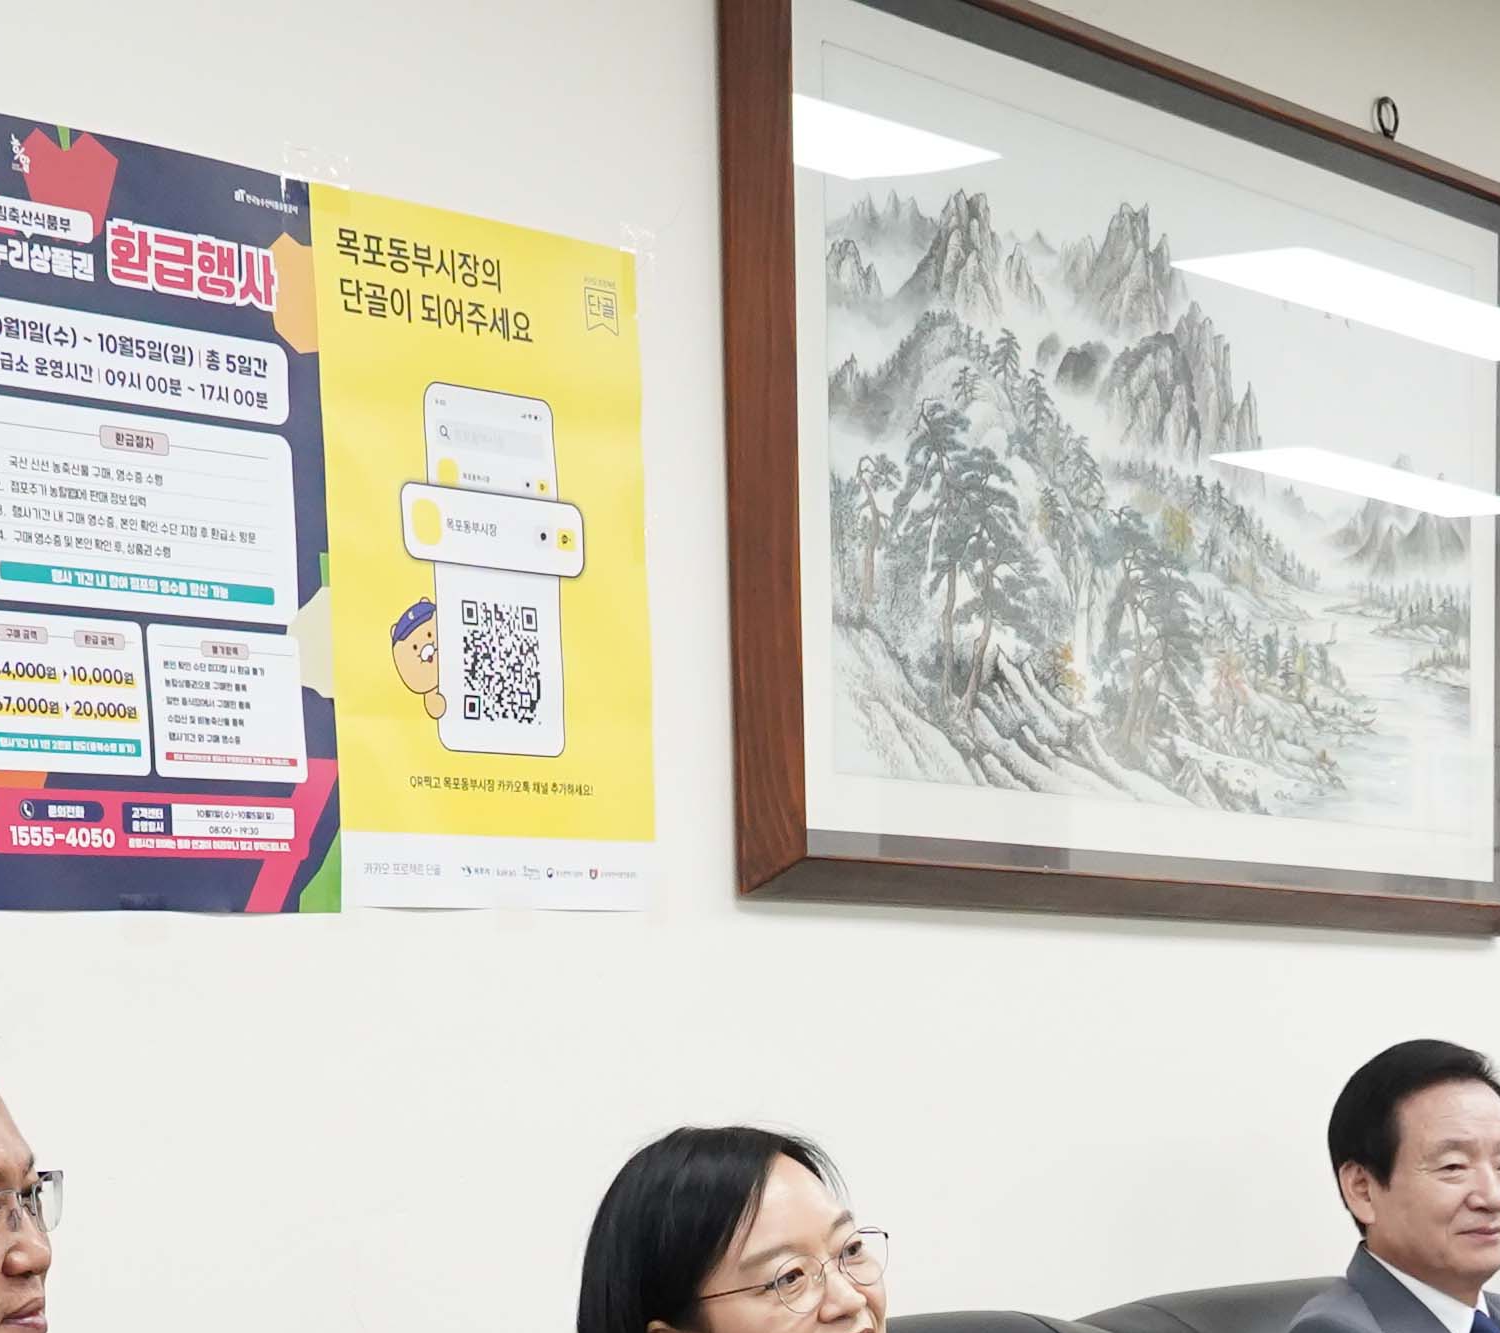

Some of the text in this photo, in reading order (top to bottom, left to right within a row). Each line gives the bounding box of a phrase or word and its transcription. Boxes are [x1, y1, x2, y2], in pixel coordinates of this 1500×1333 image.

[107, 217, 277, 311] 환급행사
[336, 227, 502, 294] 목포동부시장의
[340, 277, 534, 344] 단골이 되어주세요
[587, 293, 616, 322] 단골
[97, 333, 194, 368] 10월5일(일)
[206, 349, 221, 372] 총
[226, 354, 268, 379] 5일간
[35, 356, 93, 384] 운영시간
[105, 369, 141, 391] 09시
[146, 374, 183, 397] 00분
[200, 382, 229, 404] 17시
[234, 388, 269, 410] 00분
[115, 432, 154, 450] 환급절차
[446, 518, 498, 538] 목포동부시장
[71, 665, 134, 686] 10,000원
[73, 700, 138, 720] 20,000원
[409, 775, 442, 790] QR찍고
[443, 776, 495, 793] 목포동부시장
[497, 779, 531, 794] 카카오톡
[9, 824, 116, 850] 1555-4050
